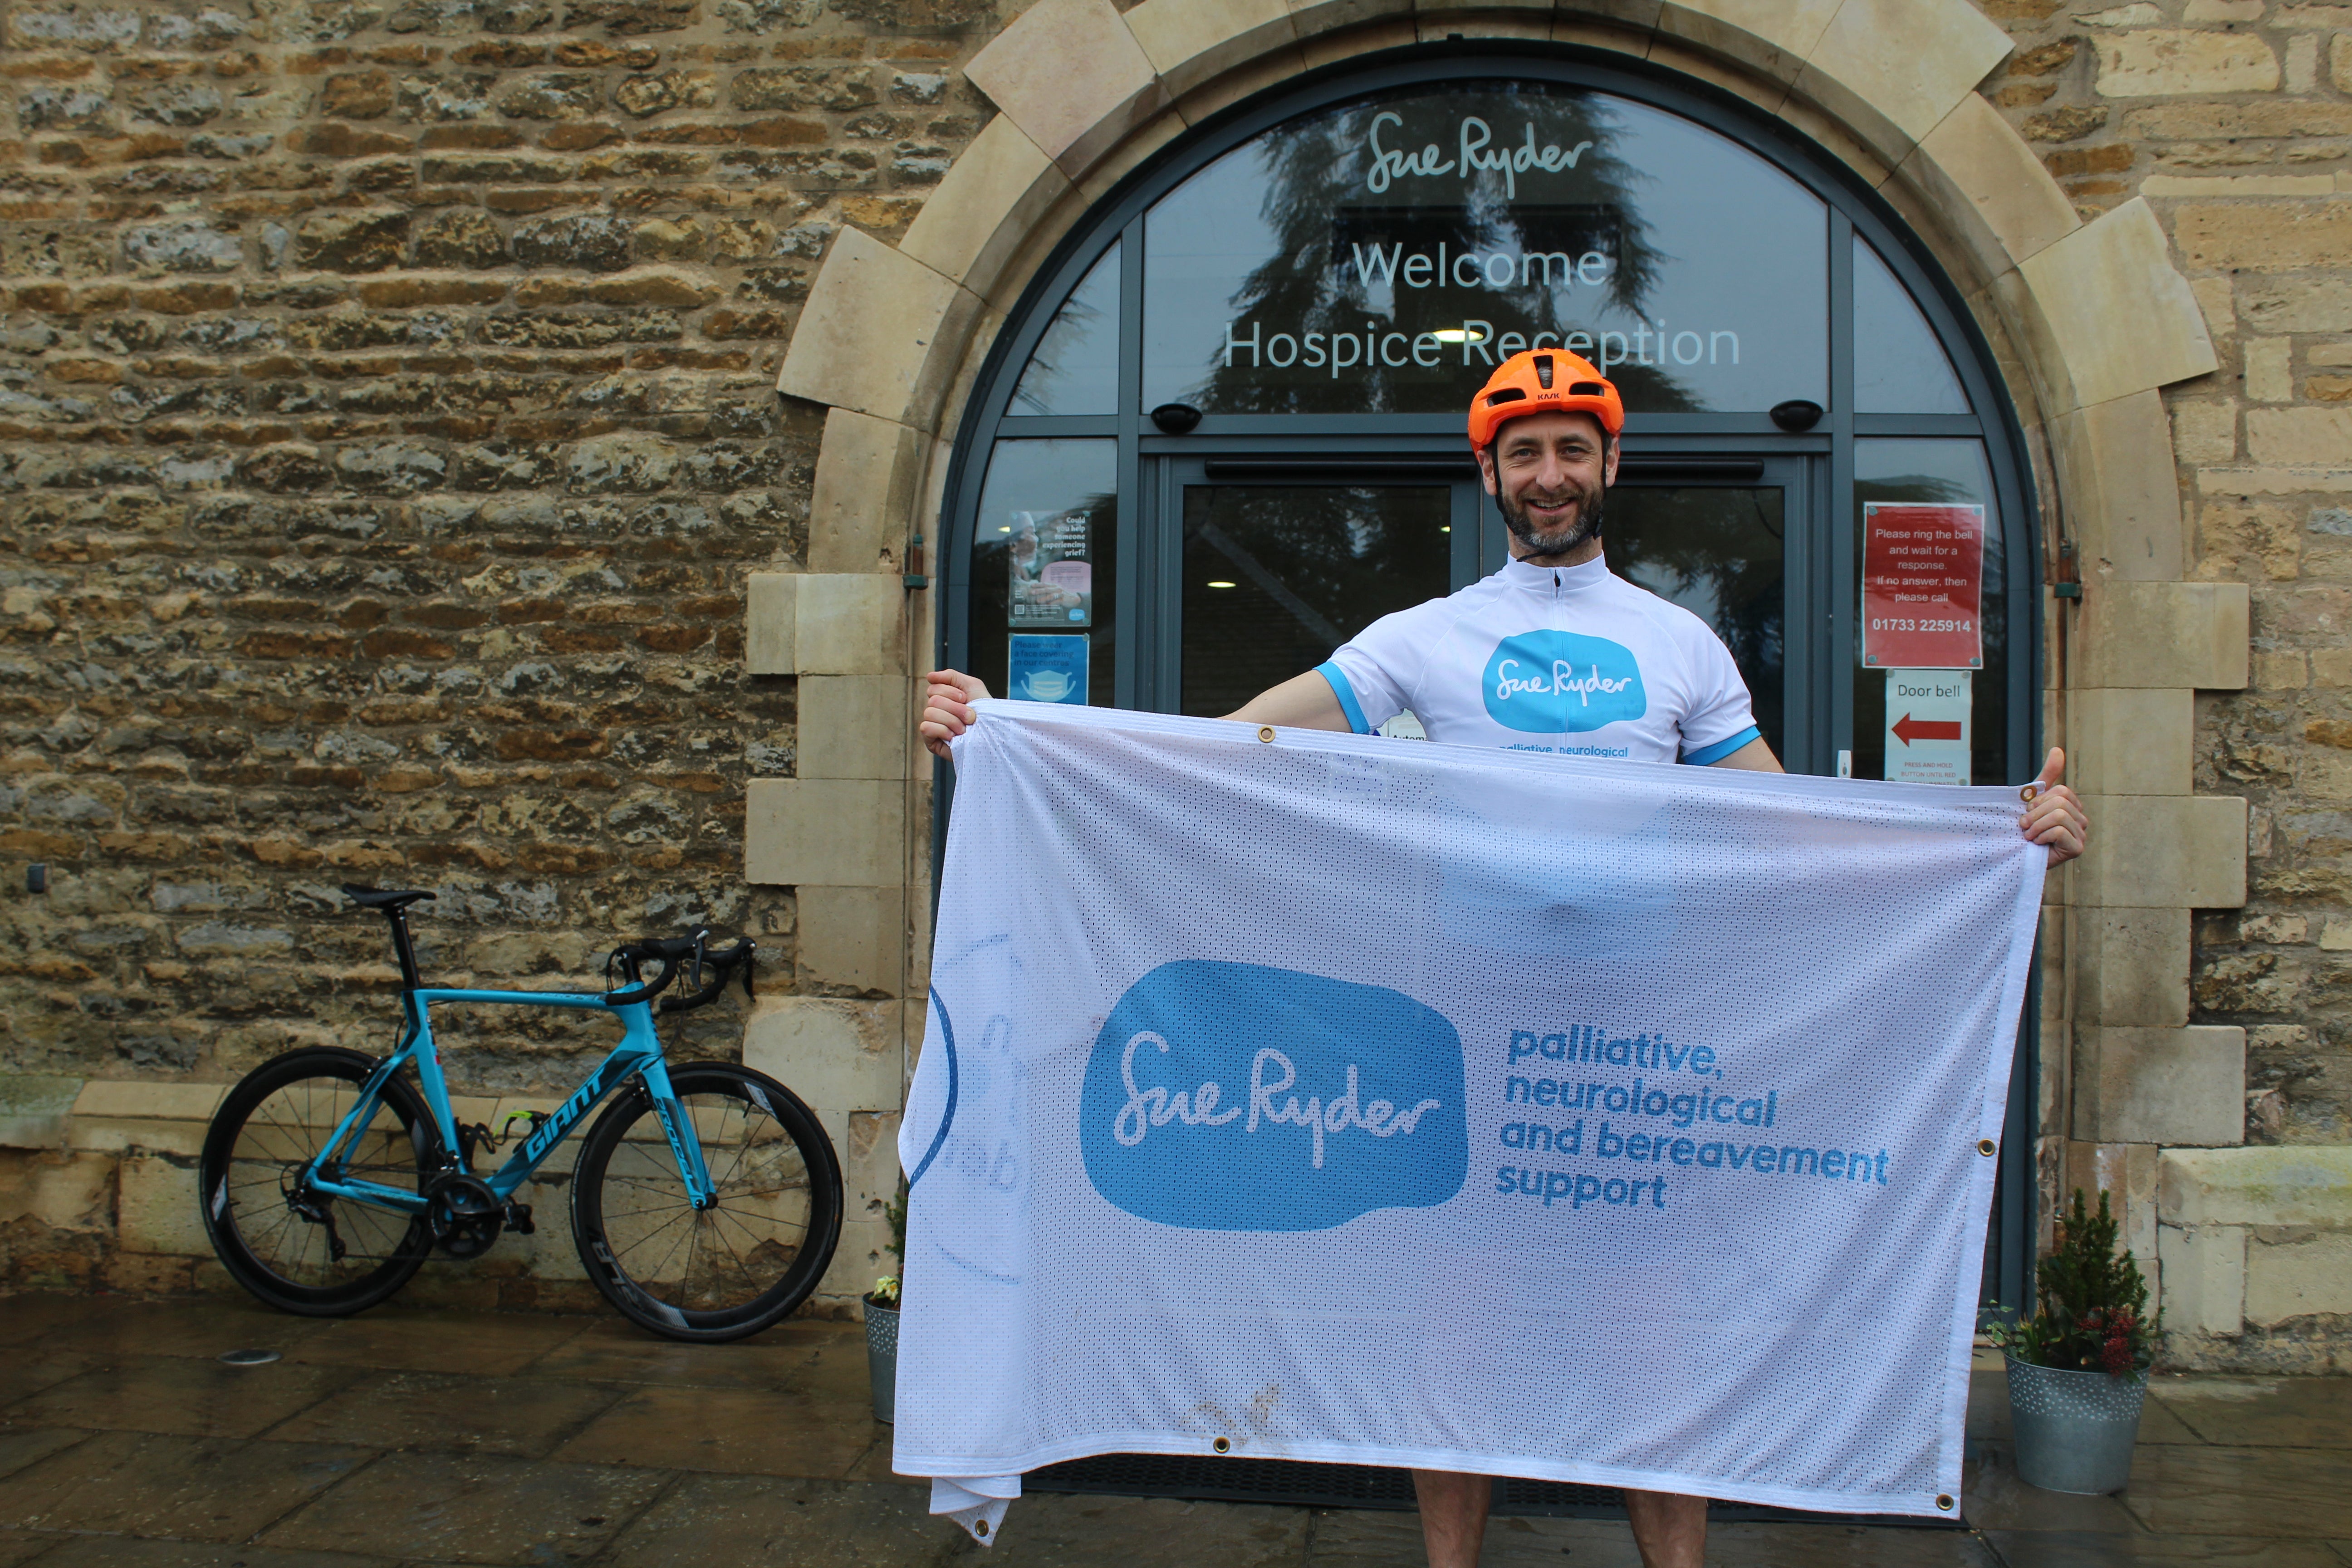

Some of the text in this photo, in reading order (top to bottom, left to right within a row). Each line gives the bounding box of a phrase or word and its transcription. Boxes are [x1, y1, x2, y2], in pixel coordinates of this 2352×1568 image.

[1367, 111, 1593, 200] Sue Ryder
[1352, 242, 1608, 288] Welcome
[1225, 320, 1442, 379] Hospice
[1071, 525, 1086, 533] help
[1876, 529, 1972, 540] Please ring the bell
[1042, 541, 1086, 549] experiencing
[1889, 546, 1908, 554] and
[1912, 546, 1932, 555] wait
[1935, 546, 1949, 555] for
[1065, 549, 1086, 557] grief?
[1898, 562, 1947, 571] response.
[1877, 576, 1884, 584] If
[1902, 578, 1941, 587] answer,
[1945, 577, 1967, 586] then
[1895, 593, 1948, 603] please call
[1872, 618, 1971, 632] 01733 225914
[1496, 659, 1632, 707] Sue Ryder
[1898, 685, 1960, 697] Door bell
[1559, 745, 1628, 757] neurological
[1507, 1024, 1722, 1080] palliative,
[1113, 1031, 1242, 1147] Sue
[1246, 1047, 1441, 1169] Ryder
[1504, 1076, 1777, 1128] neurological
[526, 1066, 606, 1163] GIANT
[1499, 1119, 1889, 1186] and bereavement
[1495, 1166, 1668, 1210] support
